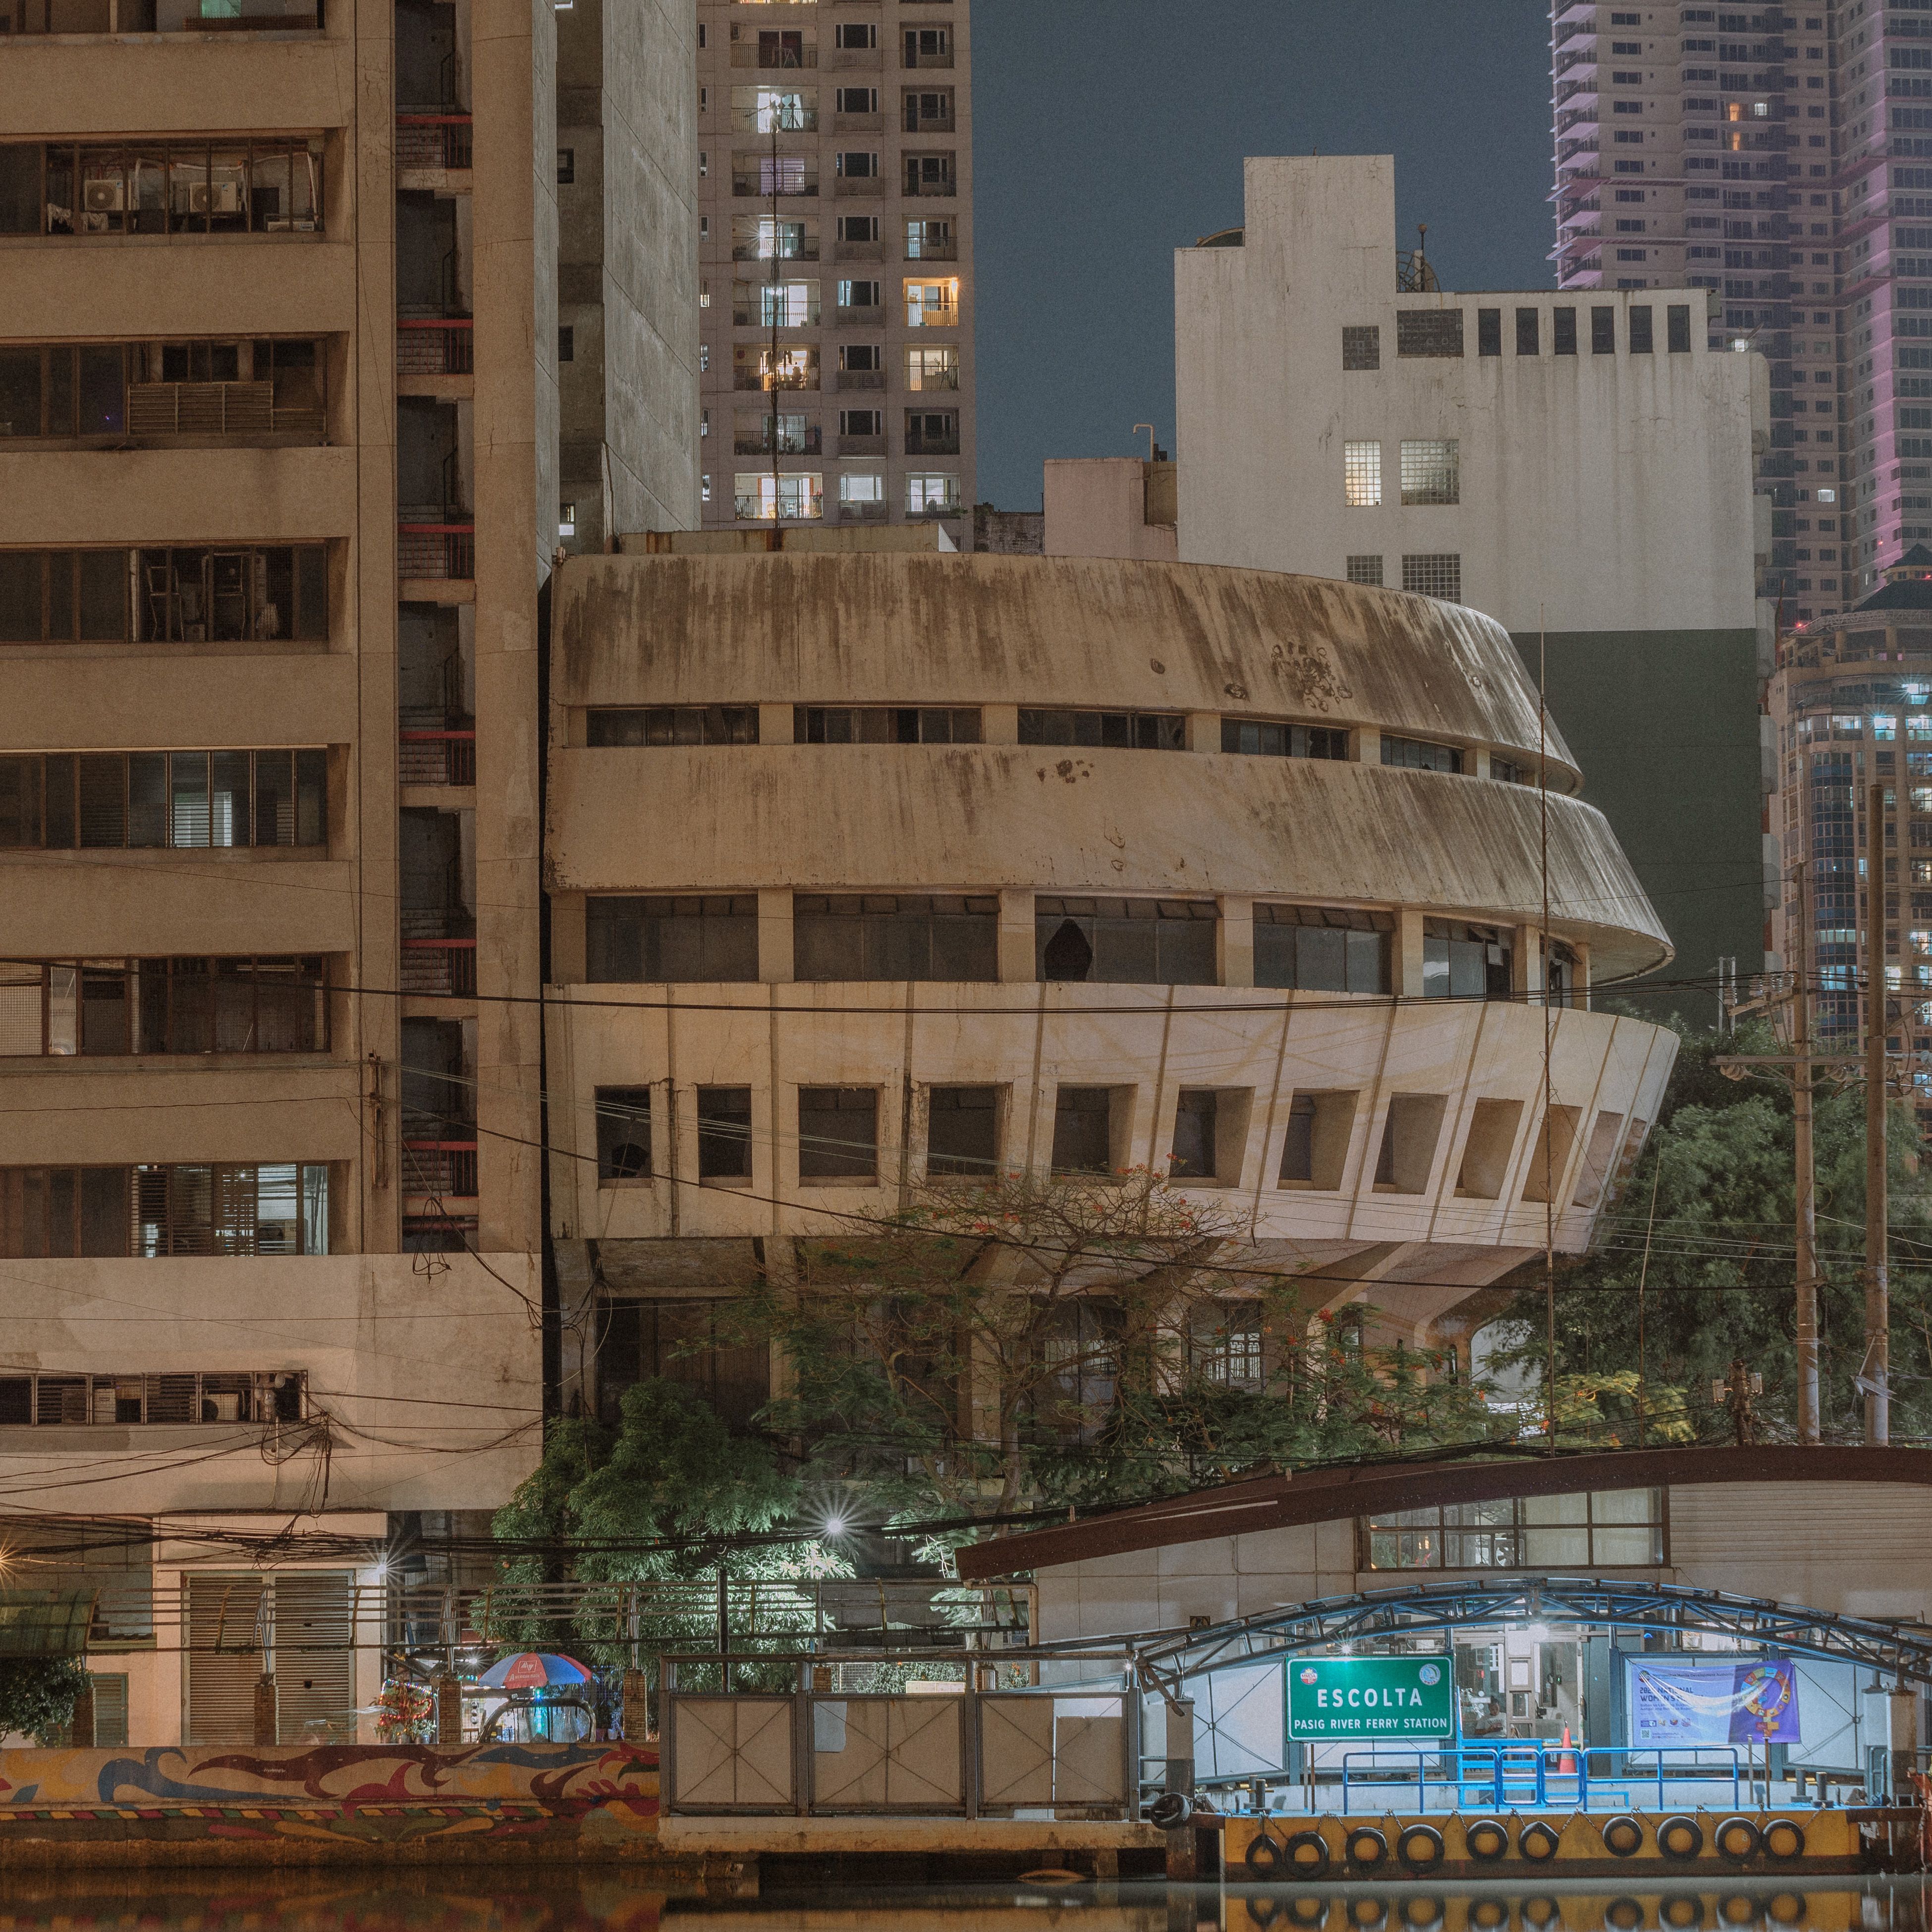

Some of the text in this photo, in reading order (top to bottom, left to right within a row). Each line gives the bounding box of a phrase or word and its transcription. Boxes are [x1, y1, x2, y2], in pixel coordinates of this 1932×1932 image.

[1318, 1688, 1422, 1707] ESCOLTA
[1294, 1718, 1446, 1729] PASIG RIVER FERRY STATION
